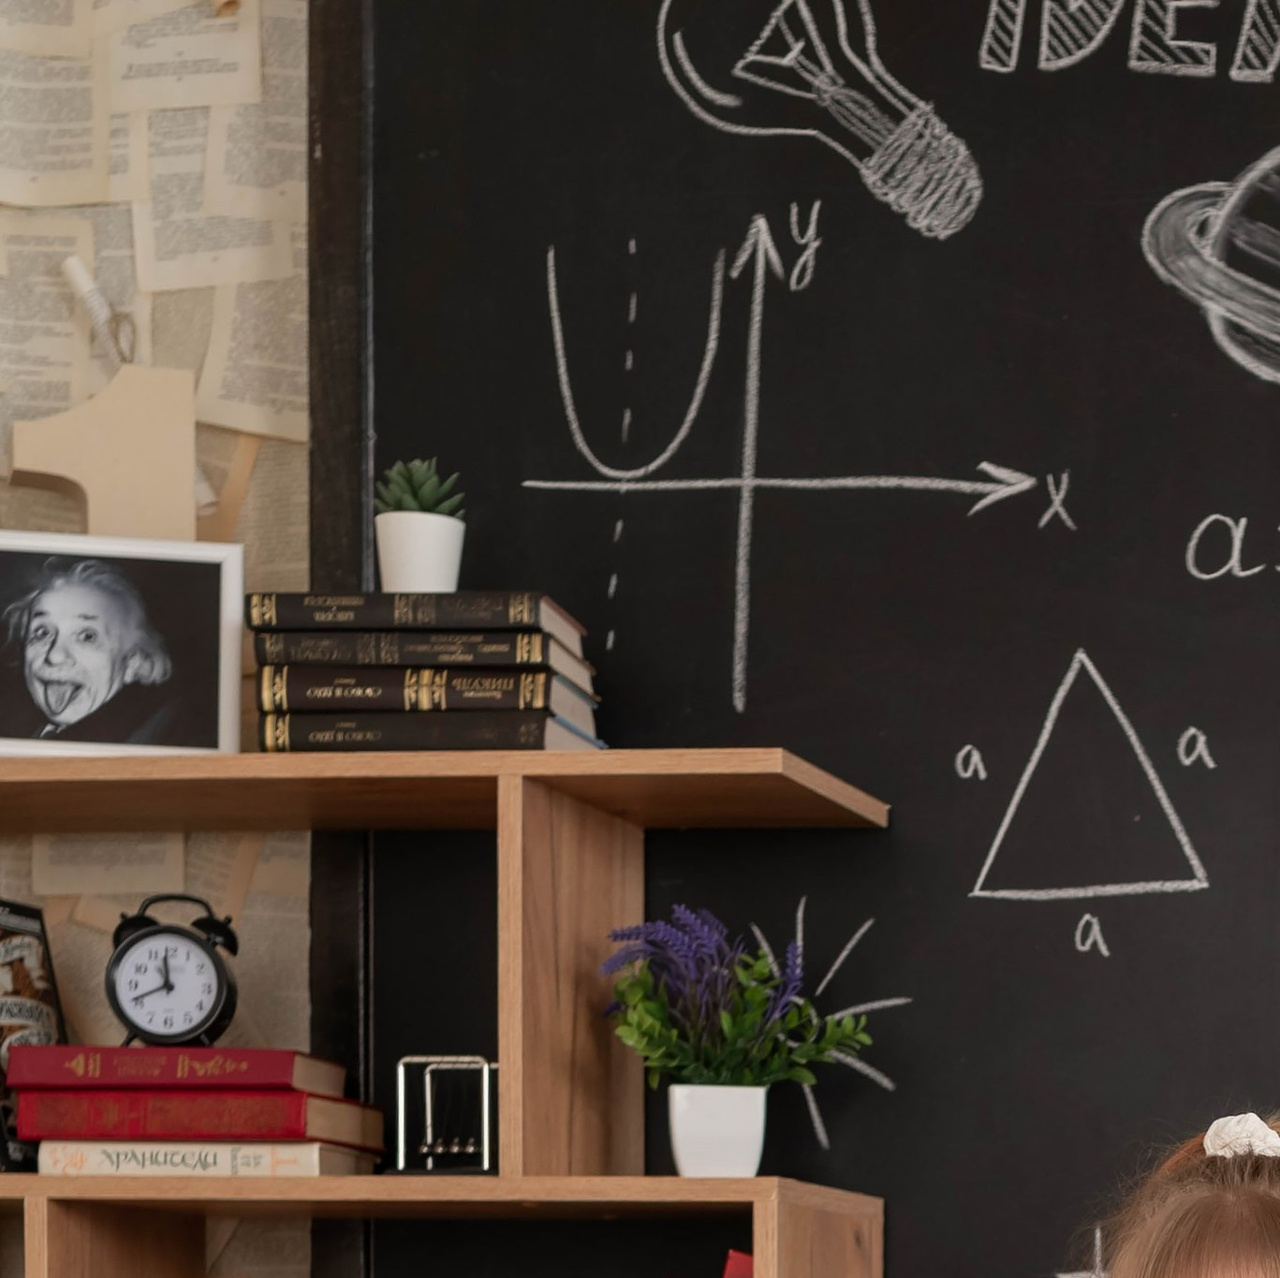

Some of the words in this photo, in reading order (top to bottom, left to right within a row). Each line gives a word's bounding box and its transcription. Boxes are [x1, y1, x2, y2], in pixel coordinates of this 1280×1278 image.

[955, 744, 987, 780] a
[1177, 726, 1217, 769] a
[1075, 913, 1110, 957] a
